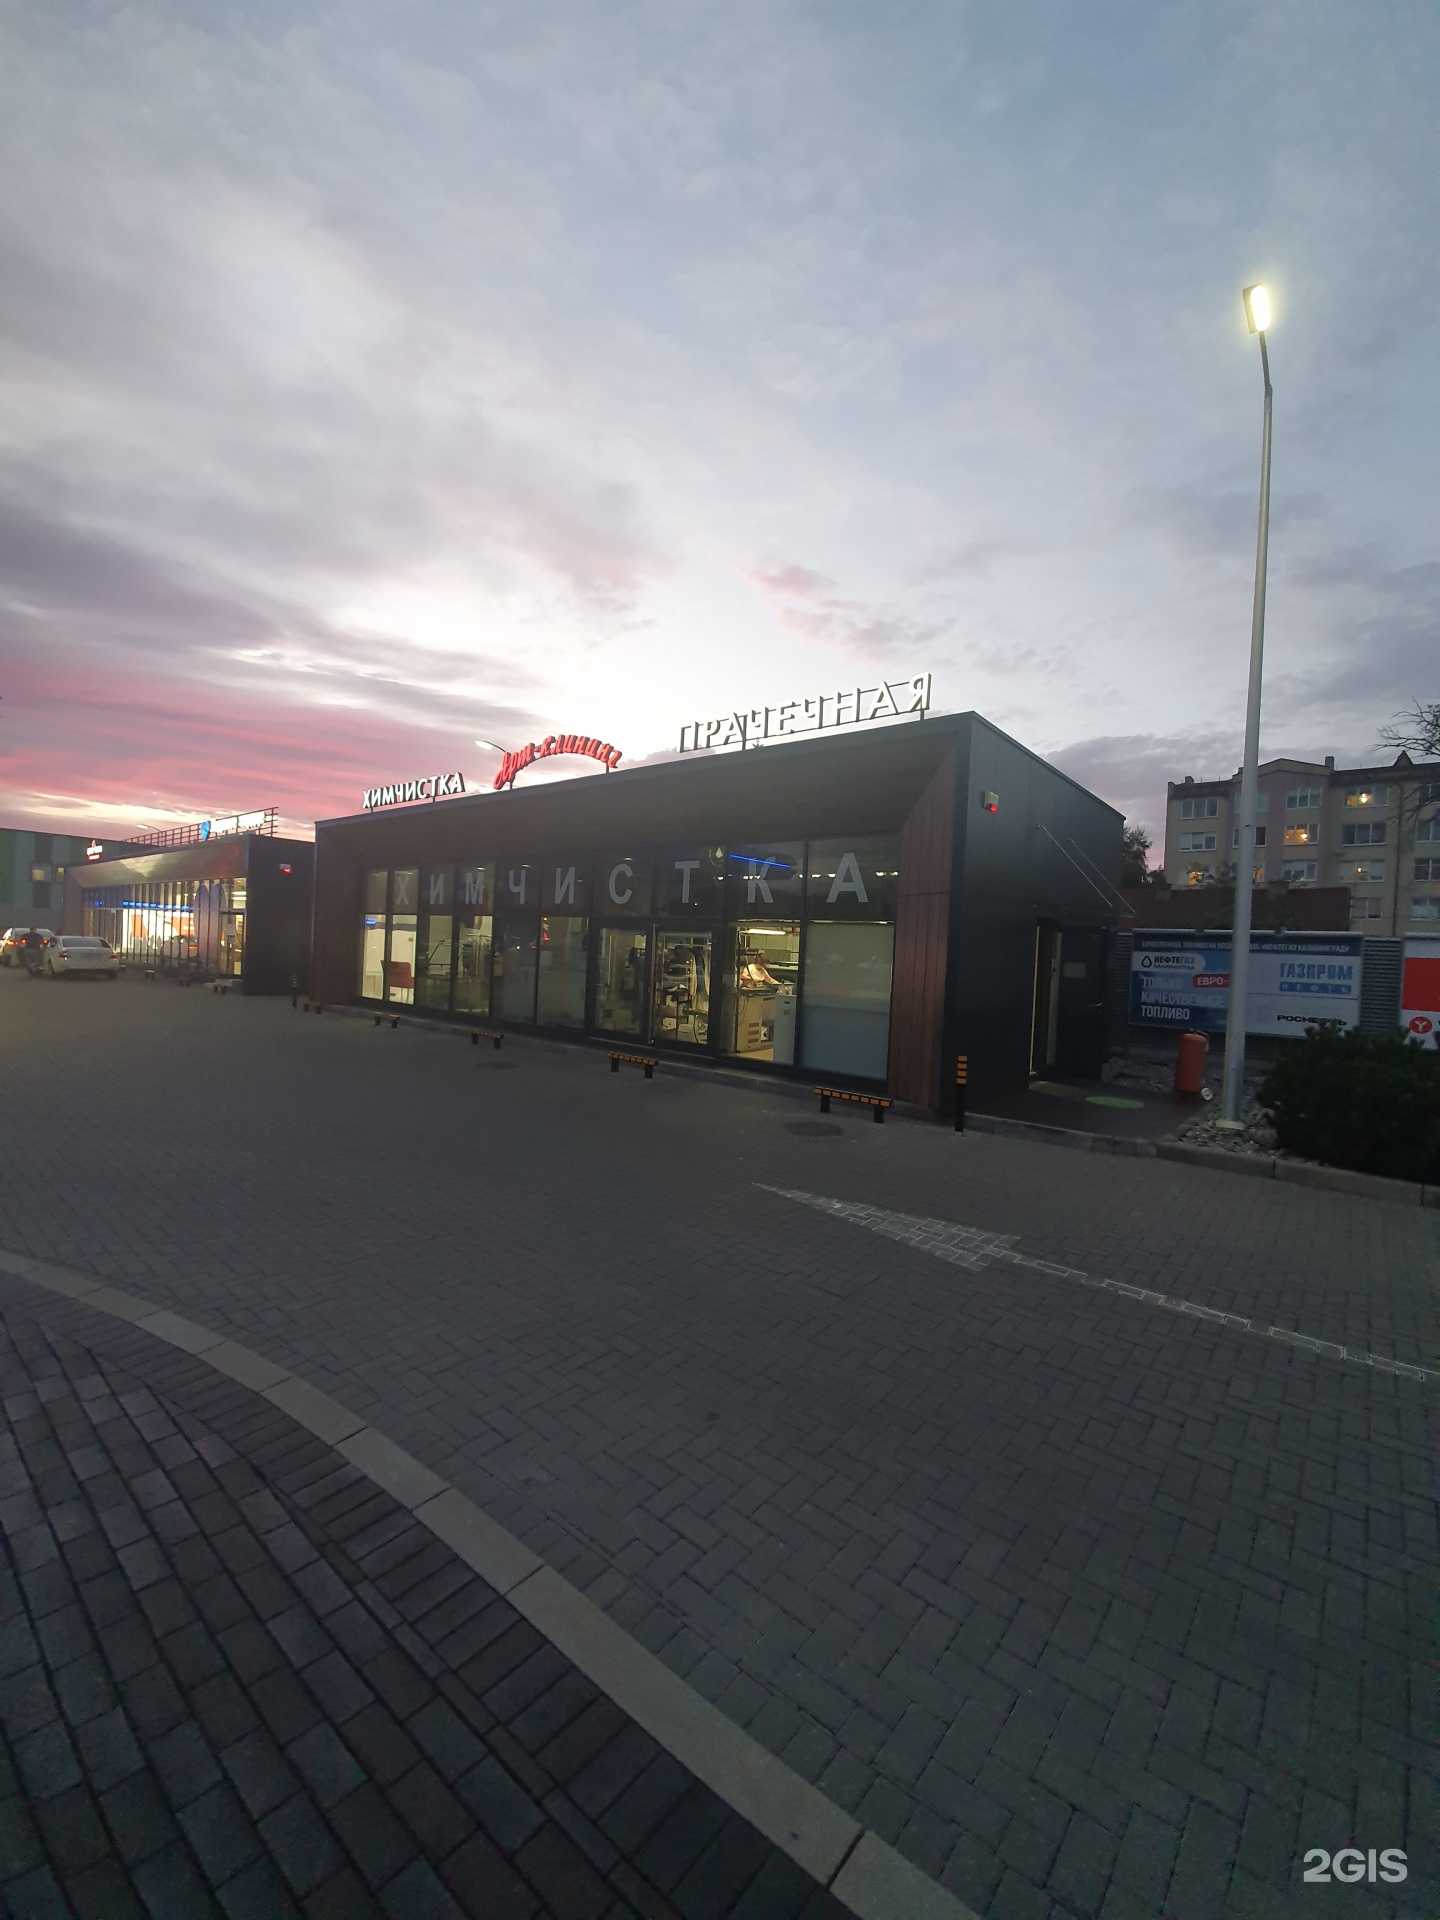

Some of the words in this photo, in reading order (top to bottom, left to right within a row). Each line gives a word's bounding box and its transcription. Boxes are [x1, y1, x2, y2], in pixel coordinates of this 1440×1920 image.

[679, 672, 932, 753] ПРАЧЕЧНАЯ
[362, 772, 466, 809] ХИМЧИСТКА
[1279, 963, 1353, 980] ГАЗПРОМ
[1197, 976, 1224, 986] ЕВРО
[1141, 1005, 1191, 1020] ТОПЛИВО
